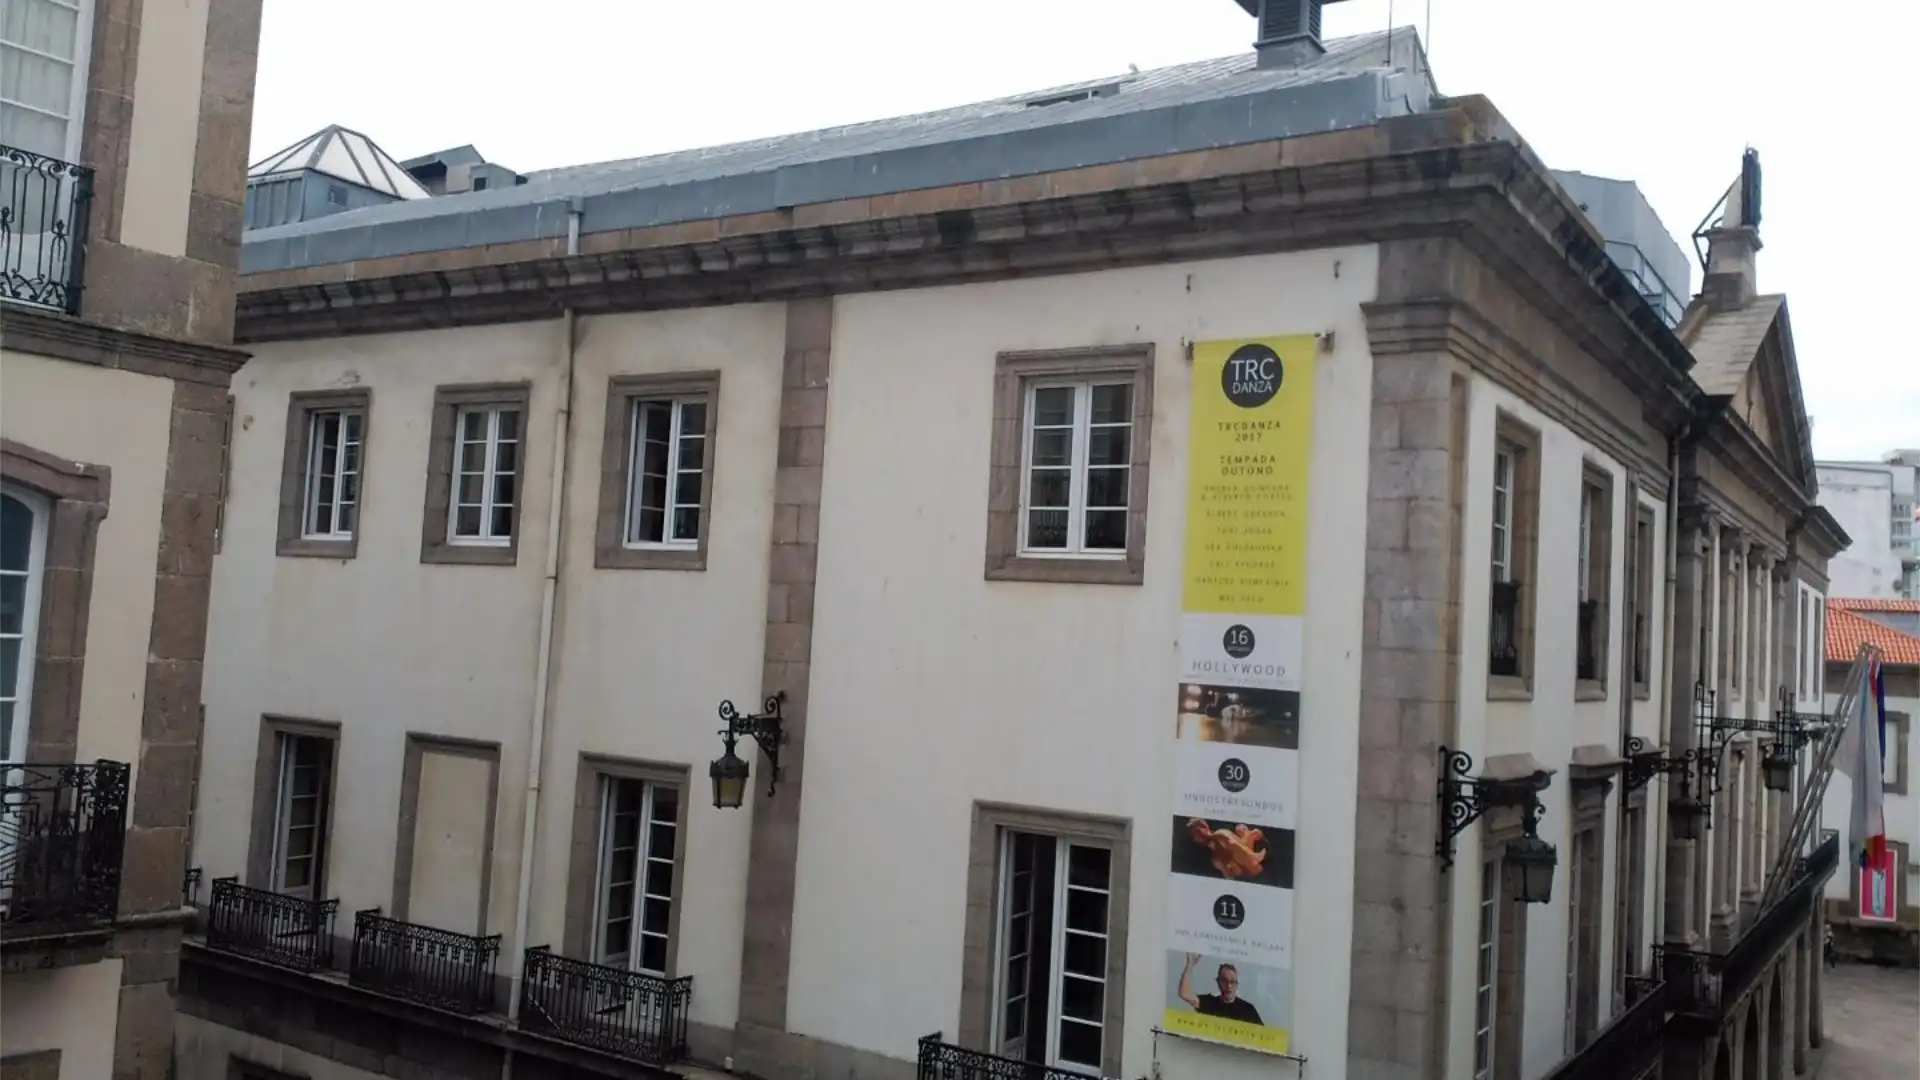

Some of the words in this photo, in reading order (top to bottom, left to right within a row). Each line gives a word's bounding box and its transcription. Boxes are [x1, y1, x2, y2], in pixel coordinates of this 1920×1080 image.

[1231, 358, 1275, 381] TRC
[1232, 381, 1273, 394] DANZA
[1218, 420, 1281, 431] TRCDANZA
[1235, 433, 1262, 443] 2017
[1220, 454, 1276, 465] TEMPADA
[1221, 466, 1274, 476] OUTONO
[1230, 630, 1248, 645] 16
[1192, 660, 1286, 677] HOLLYWOOD
[1225, 765, 1244, 780] 30
[1221, 901, 1238, 917] 11
